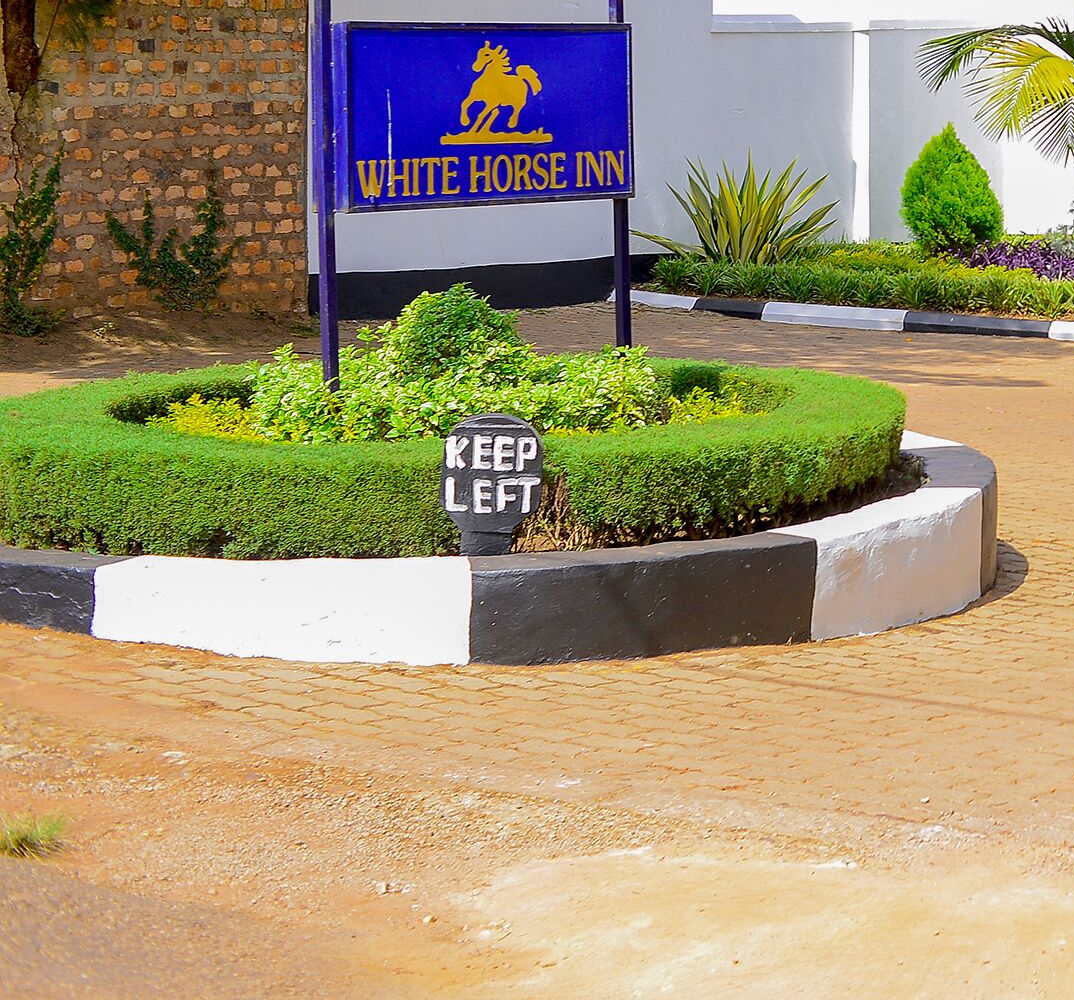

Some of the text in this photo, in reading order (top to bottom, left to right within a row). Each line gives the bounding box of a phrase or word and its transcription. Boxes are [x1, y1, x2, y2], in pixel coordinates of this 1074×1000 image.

[356, 149, 625, 199] WHITE HORSE INN
[445, 434, 538, 472] KEEP
[444, 476, 541, 514] LEFT
